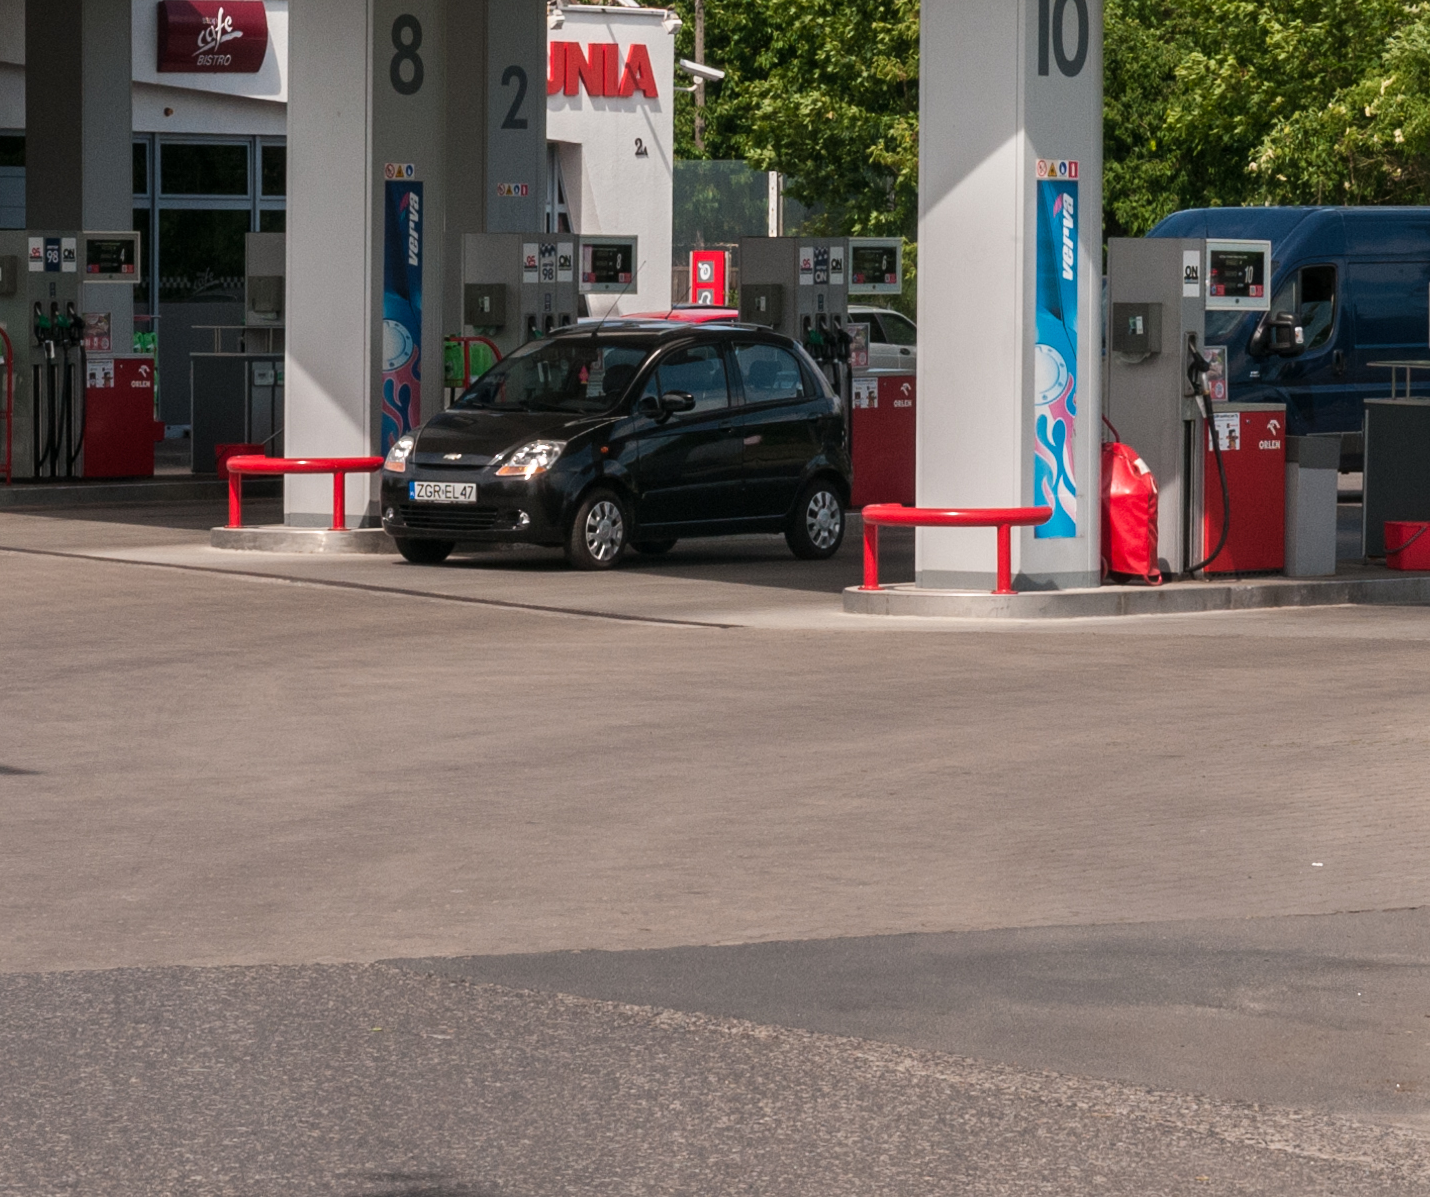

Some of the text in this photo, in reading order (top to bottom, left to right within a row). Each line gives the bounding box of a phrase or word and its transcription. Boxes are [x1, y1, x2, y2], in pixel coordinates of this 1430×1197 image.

[197, 55, 231, 66] BISTRO
[390, 14, 424, 95] 8
[547, 41, 659, 98] JNIA
[501, 65, 528, 129] 2
[409, 191, 420, 267] verva
[1062, 193, 1074, 281] verva
[47, 251, 59, 263] 98
[542, 268, 554, 281] 98
[815, 271, 827, 282] ON
[131, 380, 151, 388] ORLEN
[894, 399, 912, 408] ORLEN
[1259, 440, 1281, 450] ORLEN
[417, 483, 474, 500] ZGR EL47
